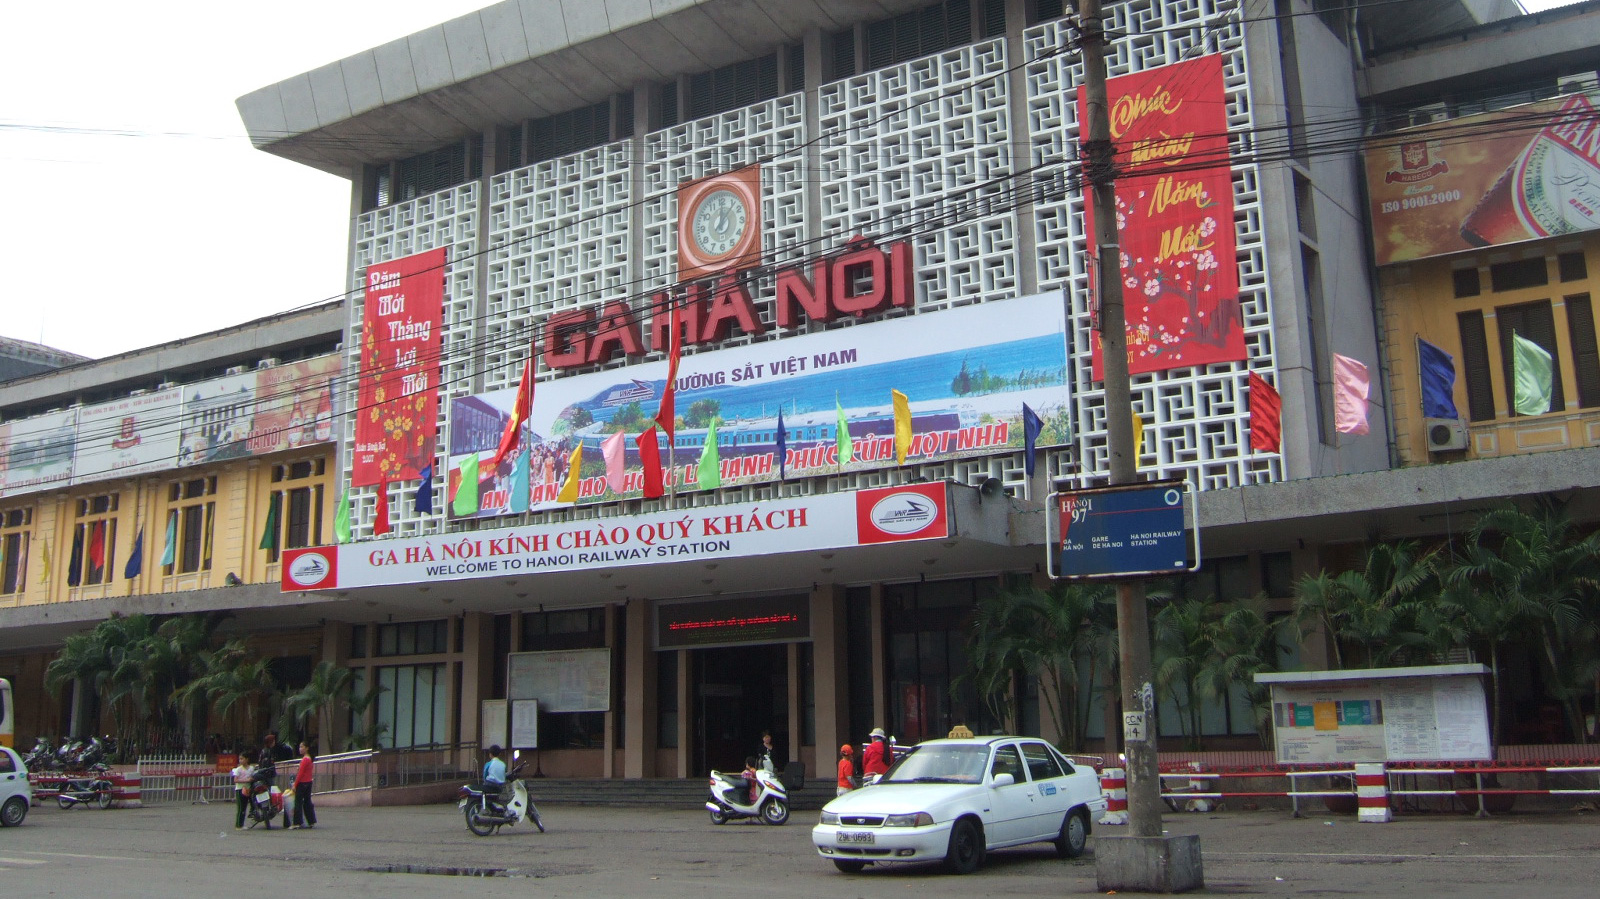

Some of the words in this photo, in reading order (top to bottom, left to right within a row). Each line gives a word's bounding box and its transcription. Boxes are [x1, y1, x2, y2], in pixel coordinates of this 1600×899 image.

[1110, 85, 1183, 139] Chúc
[1402, 171, 1432, 181] HABECO
[1148, 175, 1212, 218] Năm
[1381, 201, 1400, 214] ISO
[1569, 198, 1594, 217] BEER
[544, 299, 649, 369] GA
[775, 234, 914, 331] NỘI
[731, 361, 764, 382] SẮT
[769, 355, 808, 376] VIỆT
[813, 348, 858, 369] NAM
[482, 490, 507, 511] AN
[907, 431, 950, 459] MỌI
[957, 419, 1009, 450] NHÀ
[1071, 507, 1087, 524] 97
[369, 550, 399, 568] GA
[405, 540, 435, 565] HÀ
[441, 537, 482, 567] NỘI
[489, 532, 550, 556] KÍNH
[556, 523, 629, 550] CHÀO
[636, 515, 693, 545] QUÝ
[702, 507, 808, 537] KHÁCH
[1073, 543, 1084, 551] NỘI
[1131, 539, 1158, 547] STATION
[1152, 530, 1182, 539] RAILWAY
[426, 560, 498, 577] WELCOME
[502, 558, 522, 570] TO
[526, 554, 574, 568] HANOI
[579, 547, 651, 564] RAILWAY
[657, 540, 730, 557] STATION
